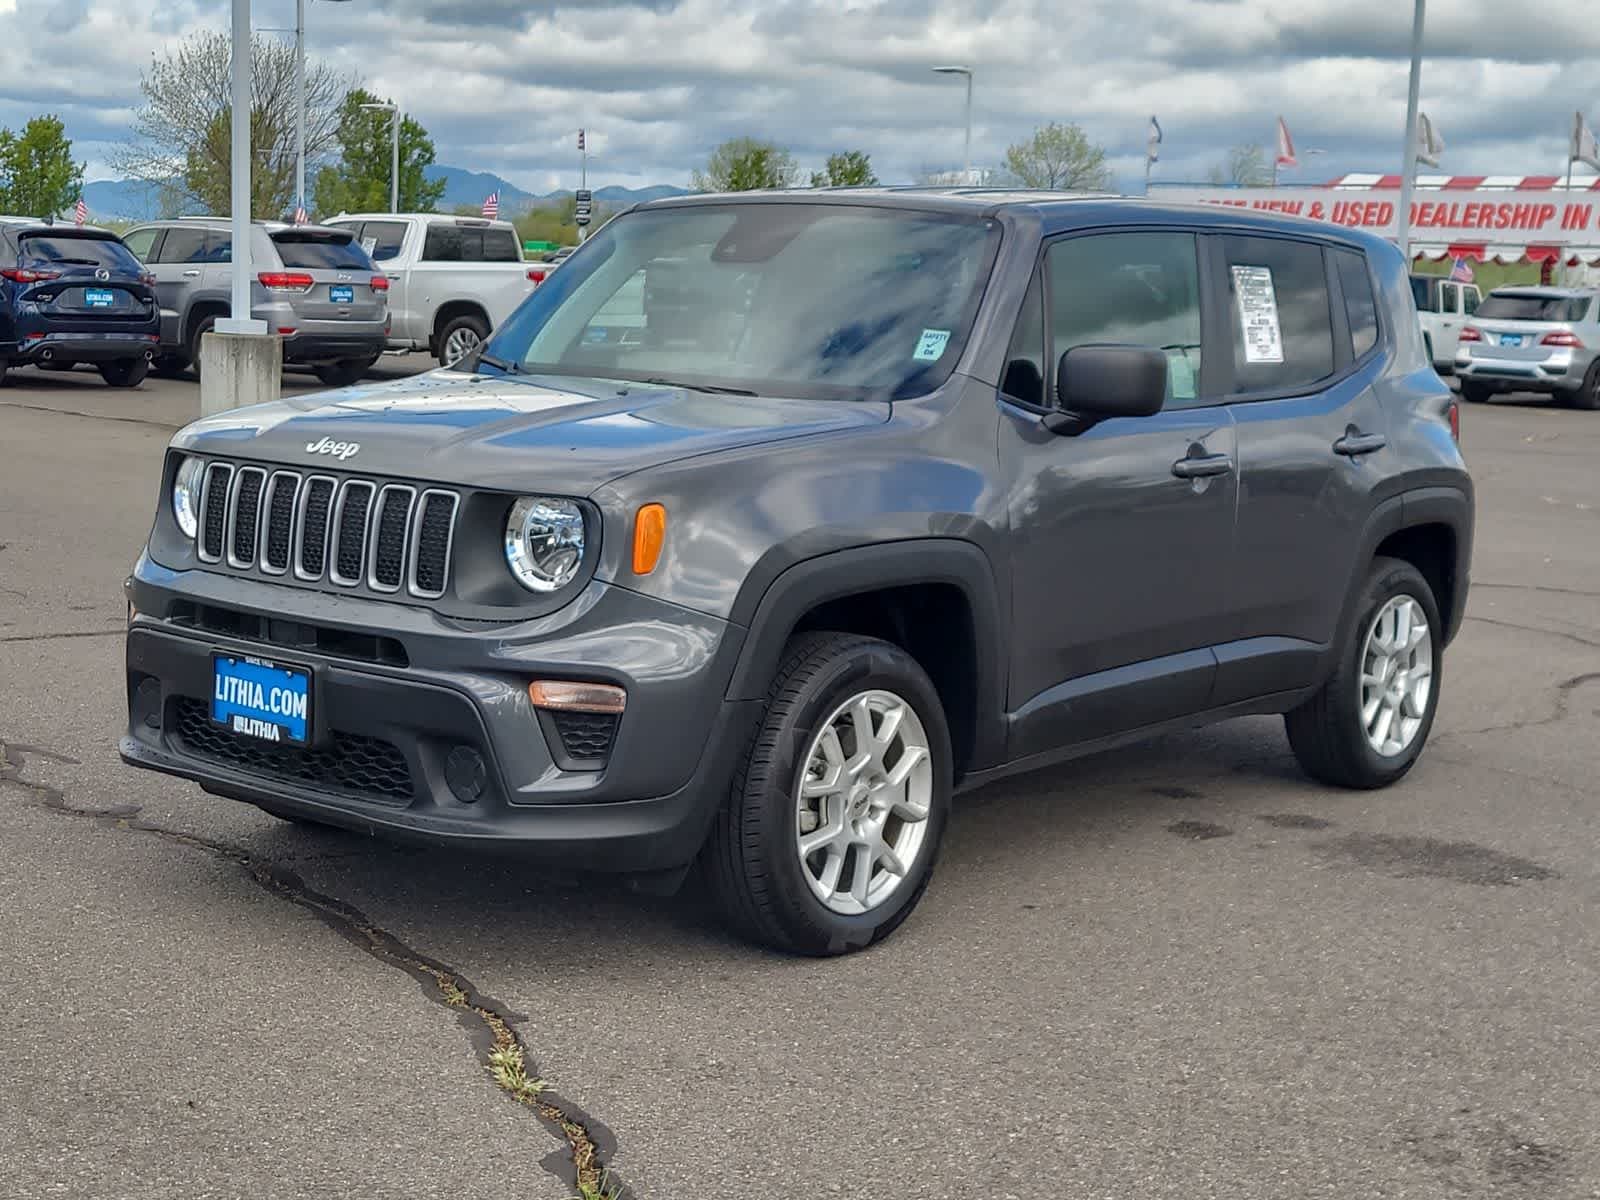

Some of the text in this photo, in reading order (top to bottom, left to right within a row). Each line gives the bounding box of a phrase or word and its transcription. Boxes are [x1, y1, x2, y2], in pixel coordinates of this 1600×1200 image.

[1308, 201, 1325, 221] &
[1330, 201, 1394, 227] USED
[1560, 203, 1593, 230] IN
[306, 436, 361, 461] Jeep
[215, 673, 308, 720] LITHIA.COM
